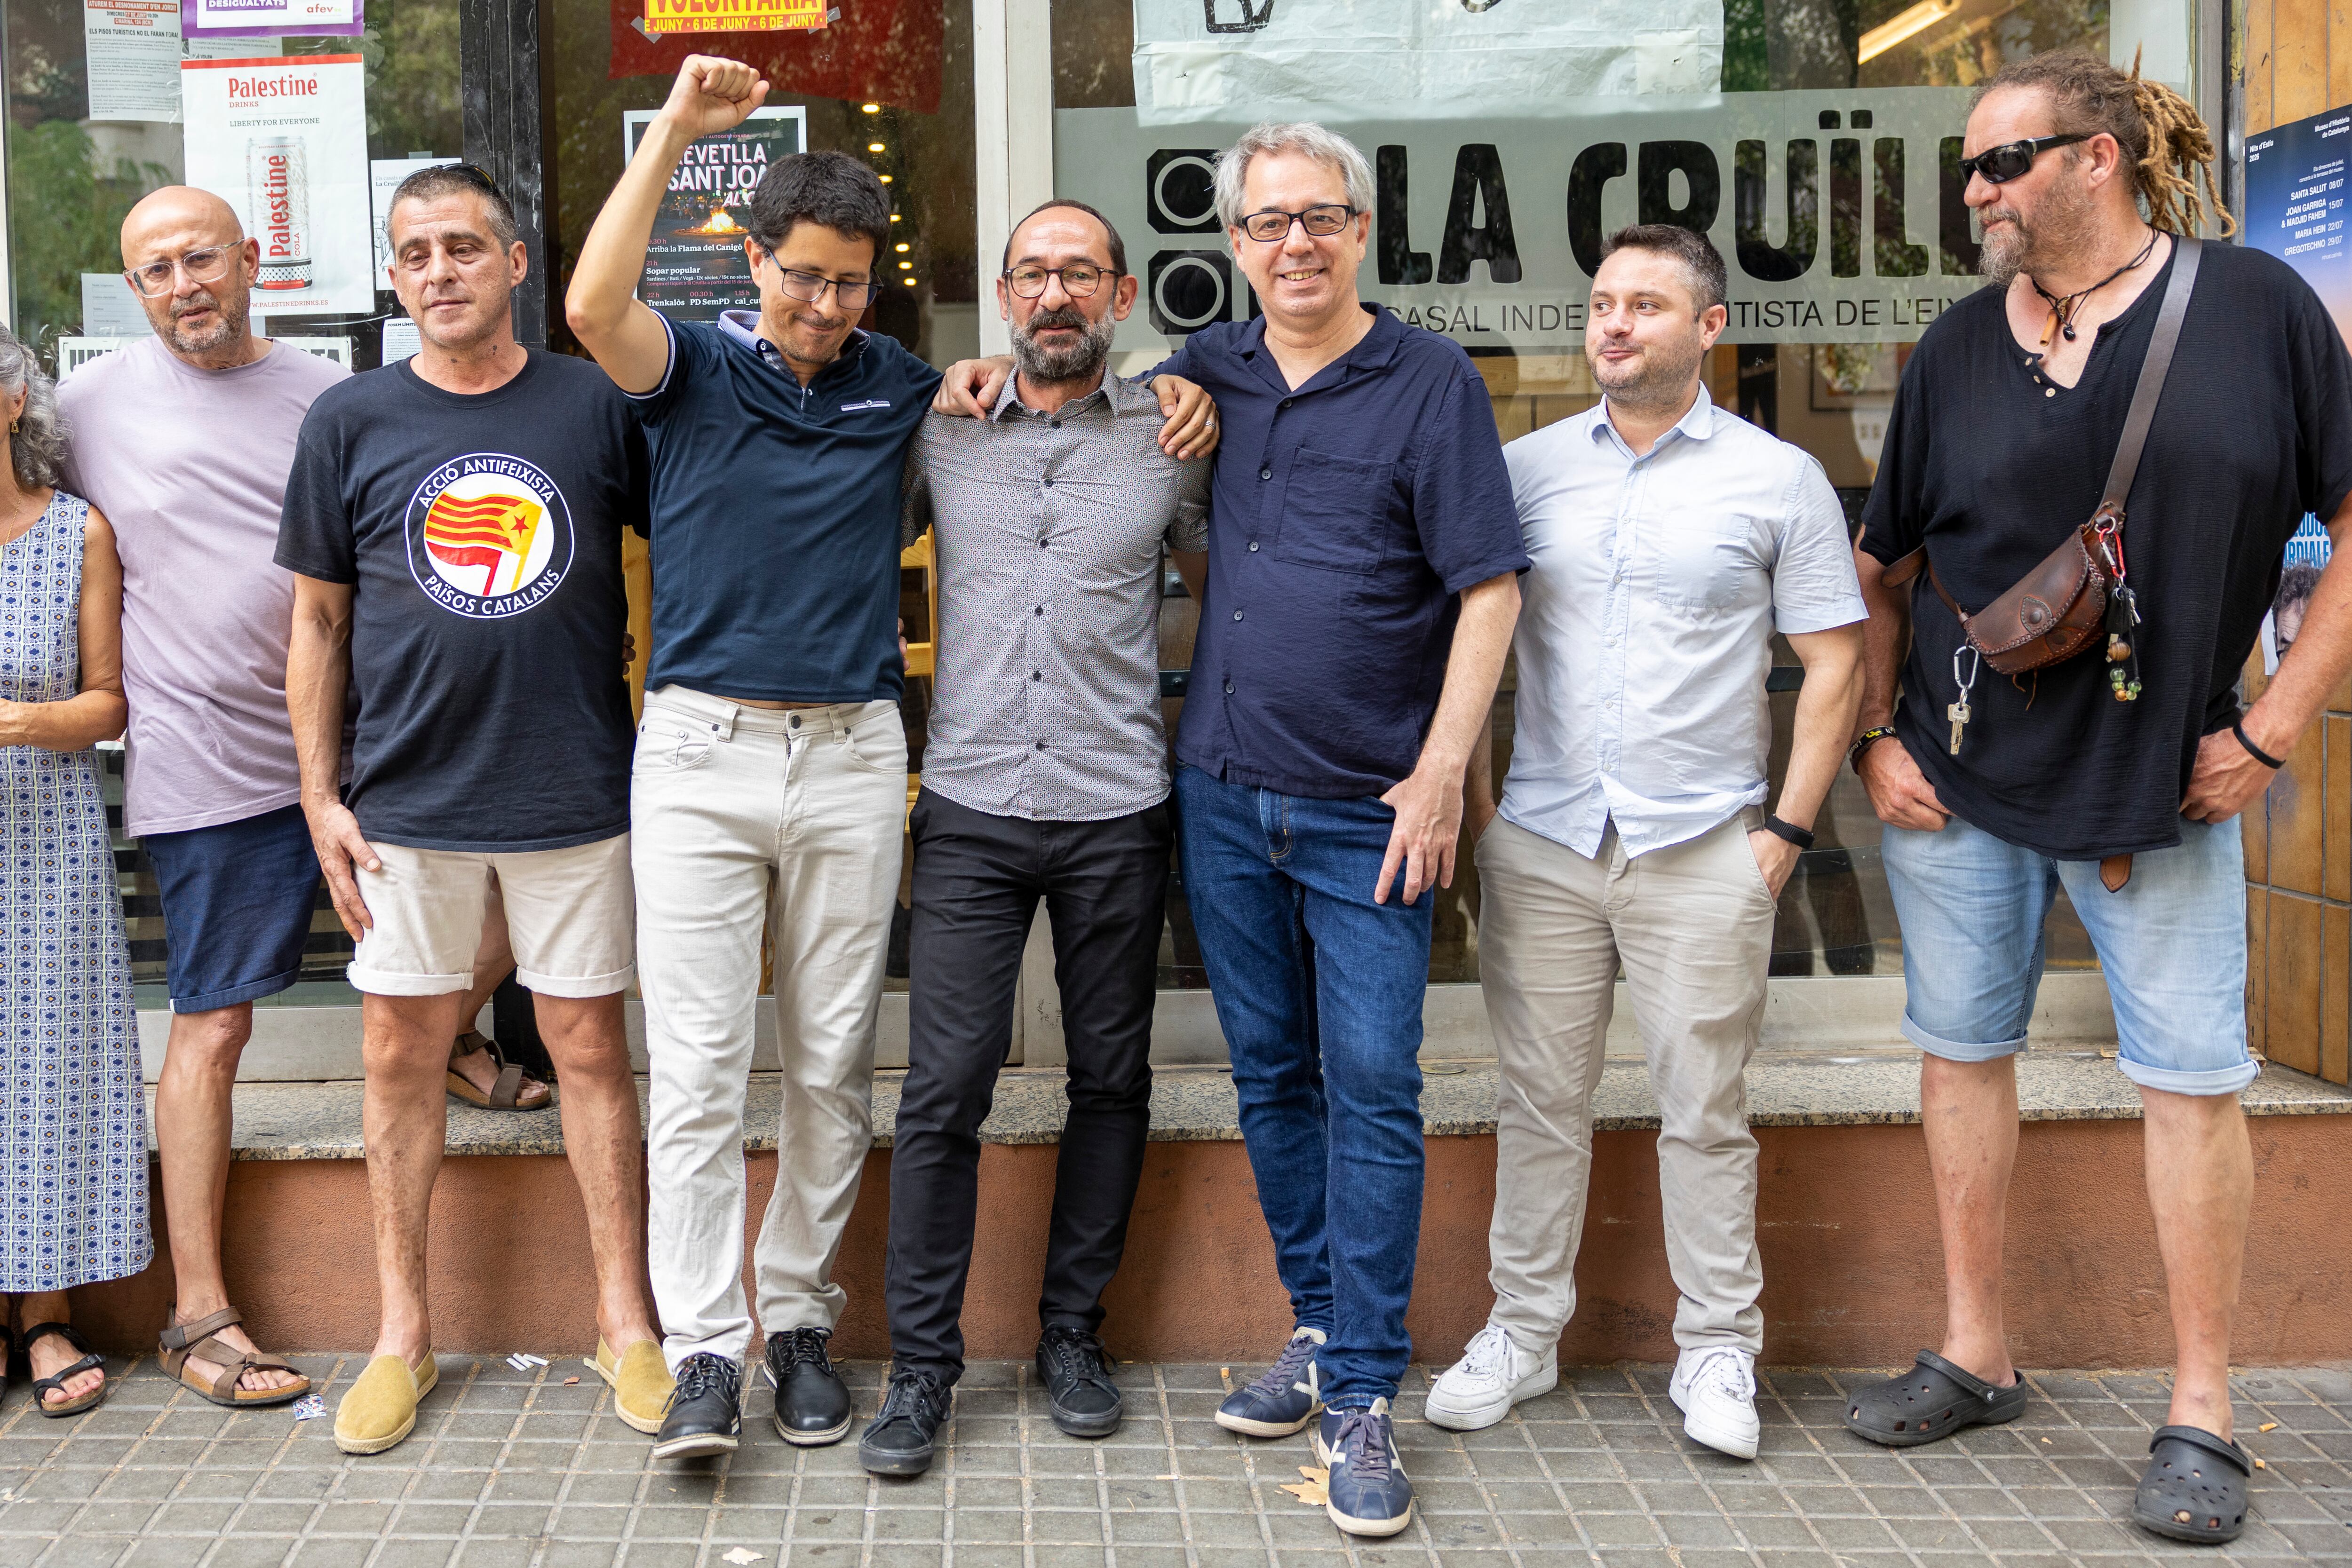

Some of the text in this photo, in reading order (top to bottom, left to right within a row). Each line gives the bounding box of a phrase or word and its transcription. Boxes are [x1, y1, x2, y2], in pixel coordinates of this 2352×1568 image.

[307, 4, 334, 13] afev
[644, 19, 651, 32] E
[653, 19, 683, 32] JUNY
[693, 18, 700, 31] 6
[703, 18, 717, 30] DE
[720, 17, 750, 30] JUNY
[760, 16, 766, 29] 6
[769, 16, 784, 29] DE
[787, 14, 817, 27] JUNY
[229, 74, 318, 98] Palestine
[2328, 125, 2350, 136] Catalunya
[679, 143, 767, 165] EVETLLA
[2249, 153, 2259, 162] 2026
[667, 166, 726, 191] SANT
[723, 191, 742, 207] AL
[1376, 109, 1985, 285] LA CRUÏLL
[2291, 178, 2344, 201] SANTA SALUT 08/07
[264, 156, 291, 256] Palestine
[2286, 198, 2327, 216] JOAN GARRIGA
[2329, 198, 2344, 210] 15/07
[2287, 214, 2307, 227] MADJID
[2308, 209, 2326, 222] FAHEM
[2295, 220, 2343, 239] MARIA HEIN 22/07
[715, 243, 743, 253] Canigó
[2284, 239, 2325, 256] GREGOTECHNO
[2328, 235, 2343, 246] 29/07
[670, 266, 701, 275] popular
[1836, 299, 1880, 326] DE
[1893, 298, 1954, 325] L'EI
[419, 459, 555, 508] ACCIÓ ANTIFEIXISTA
[2284, 541, 2333, 569] RDIALE
[424, 569, 559, 615] PAÏSOS CATALANS
